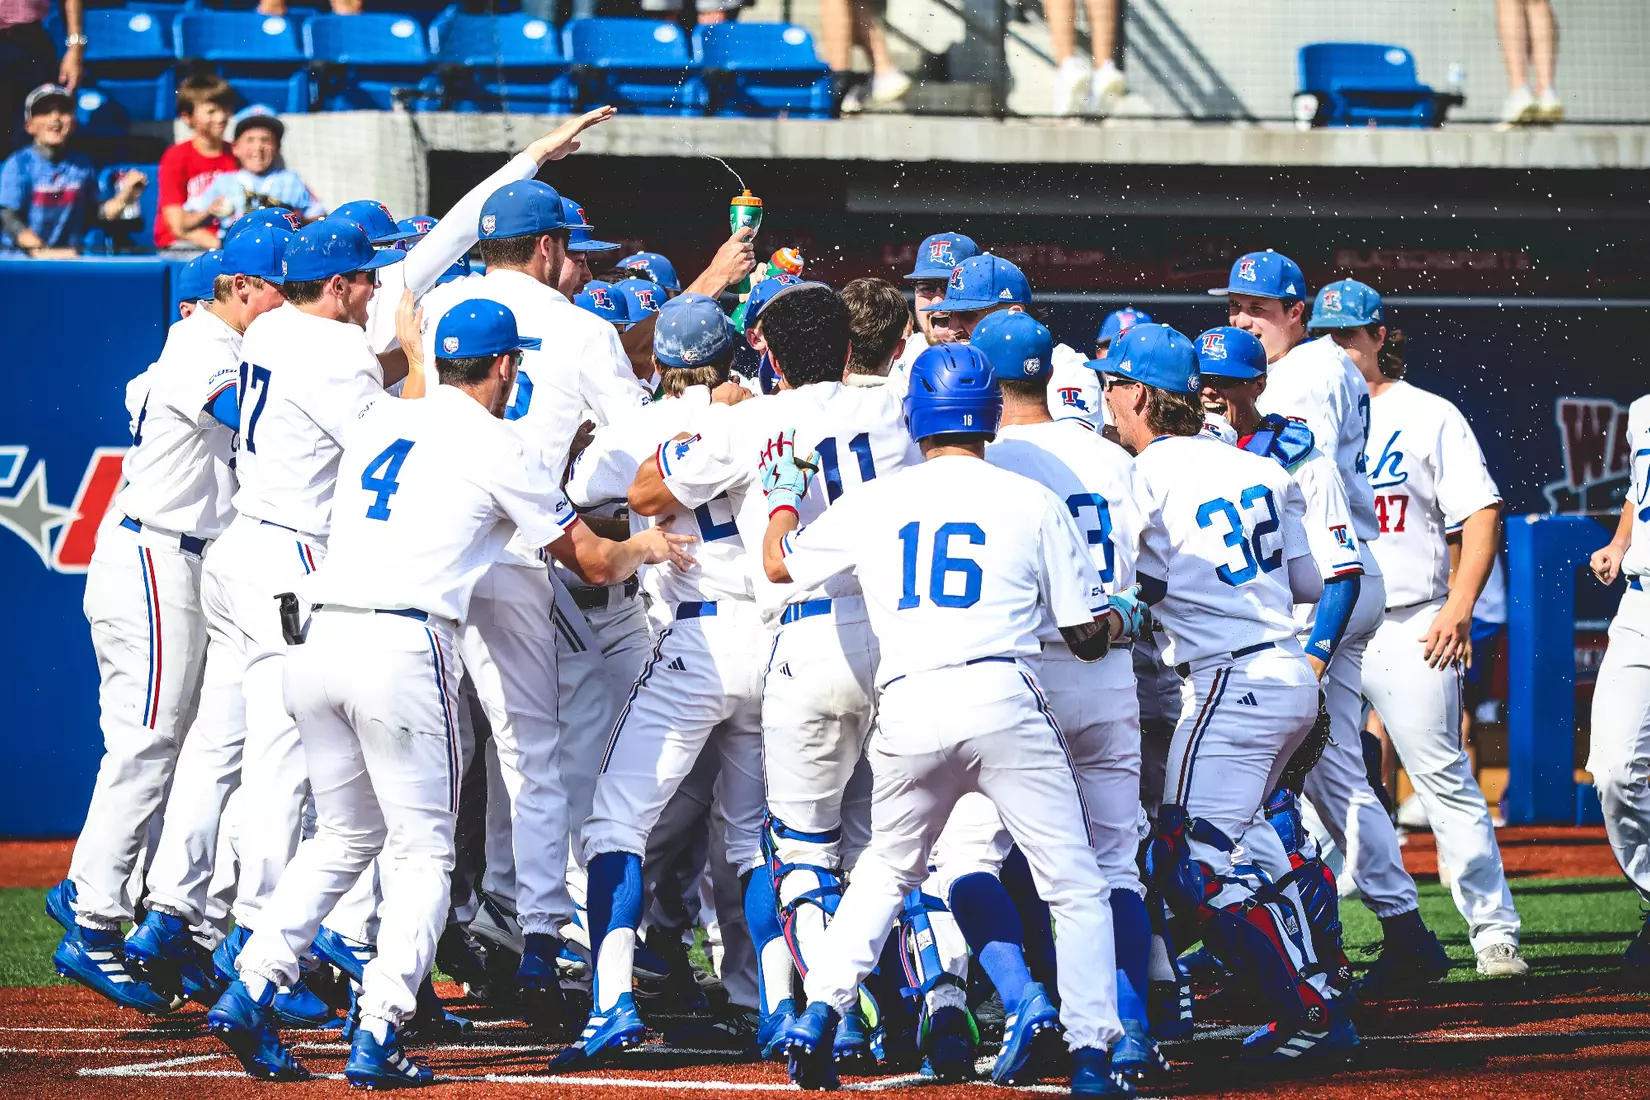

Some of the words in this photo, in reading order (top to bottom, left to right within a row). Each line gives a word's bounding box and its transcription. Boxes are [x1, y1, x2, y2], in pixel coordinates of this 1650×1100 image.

[239, 361, 272, 455] 17
[963, 414, 973, 426] 16
[361, 438, 416, 521] 4
[815, 432, 877, 506] 11
[1196, 484, 1284, 587] 32
[1374, 495, 1409, 533] 47
[898, 521, 986, 610] 16
